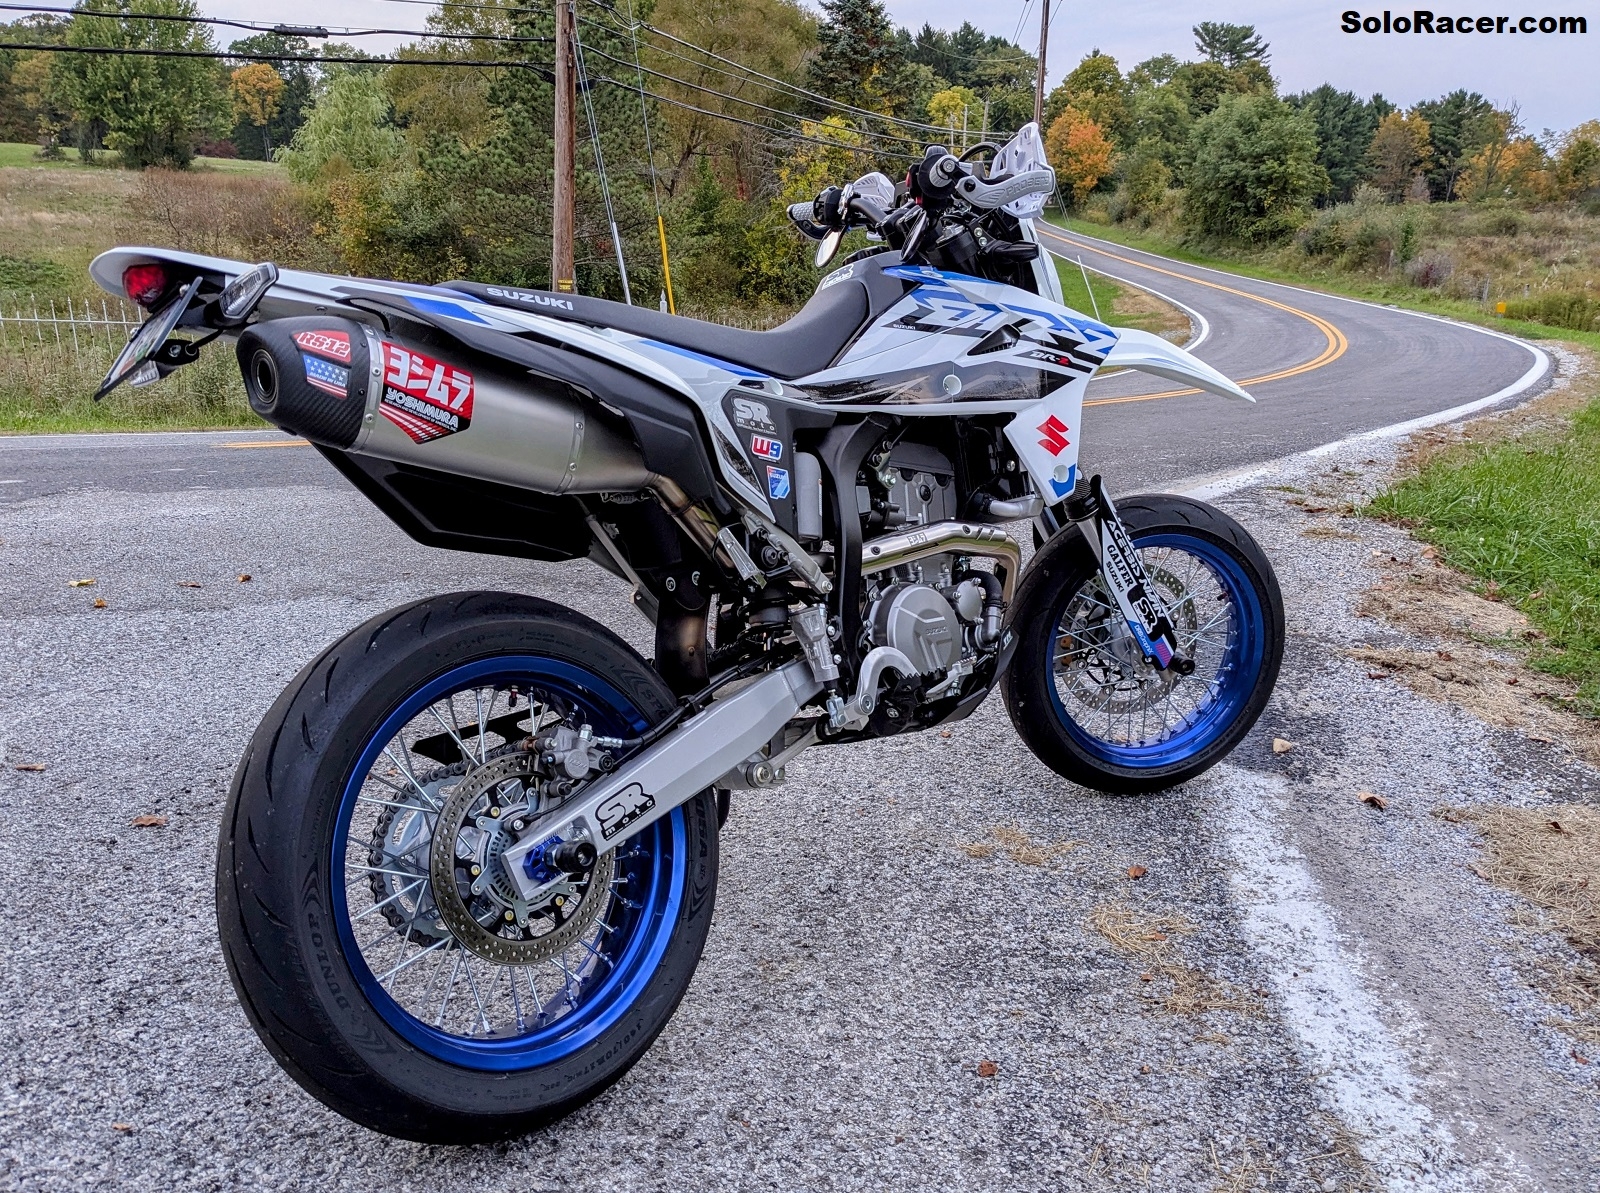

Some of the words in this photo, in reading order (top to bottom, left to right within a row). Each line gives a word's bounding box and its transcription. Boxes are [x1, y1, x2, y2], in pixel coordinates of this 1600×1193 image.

[486, 287, 574, 311] SUZUKI
[892, 323, 916, 331] SUZUKI
[386, 387, 459, 429] YOSHIMURA
[733, 398, 773, 425] SR
[1106, 520, 1140, 577] ACERBIS
[1106, 544, 1134, 588] GALFER
[1105, 561, 1125, 593] SUZUKI
[1137, 596, 1158, 631] SR
[595, 782, 653, 832] SR
[605, 799, 653, 836] moto
[307, 912, 350, 1010] DUNLOP
